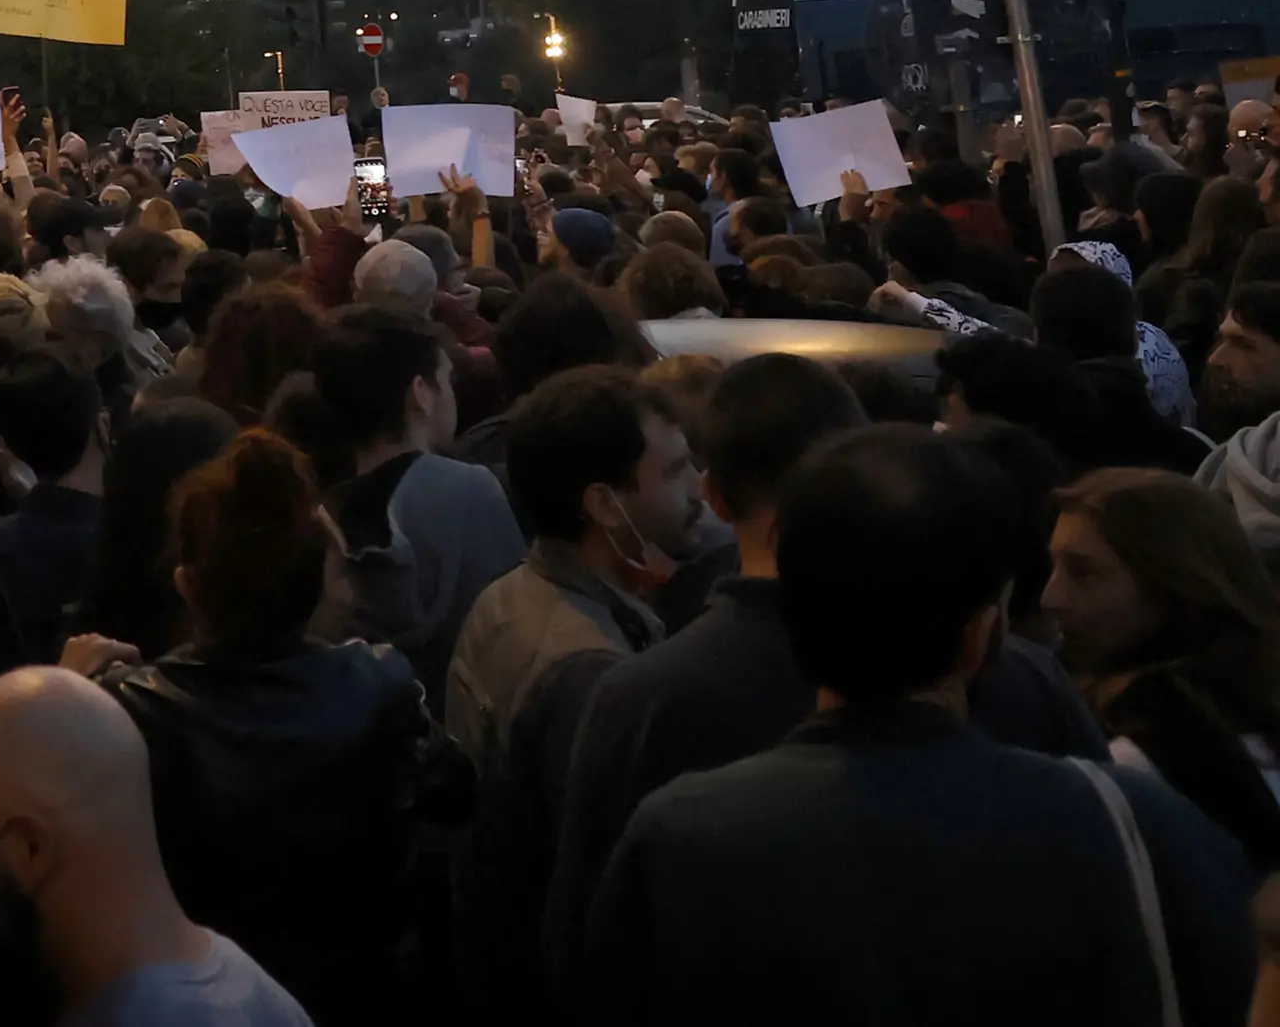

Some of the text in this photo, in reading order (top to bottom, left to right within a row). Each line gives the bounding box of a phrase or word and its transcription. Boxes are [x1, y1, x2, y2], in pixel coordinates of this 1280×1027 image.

[738, 8, 790, 30] CARABINIERI
[241, 96, 329, 114] QUESTA VOCE
